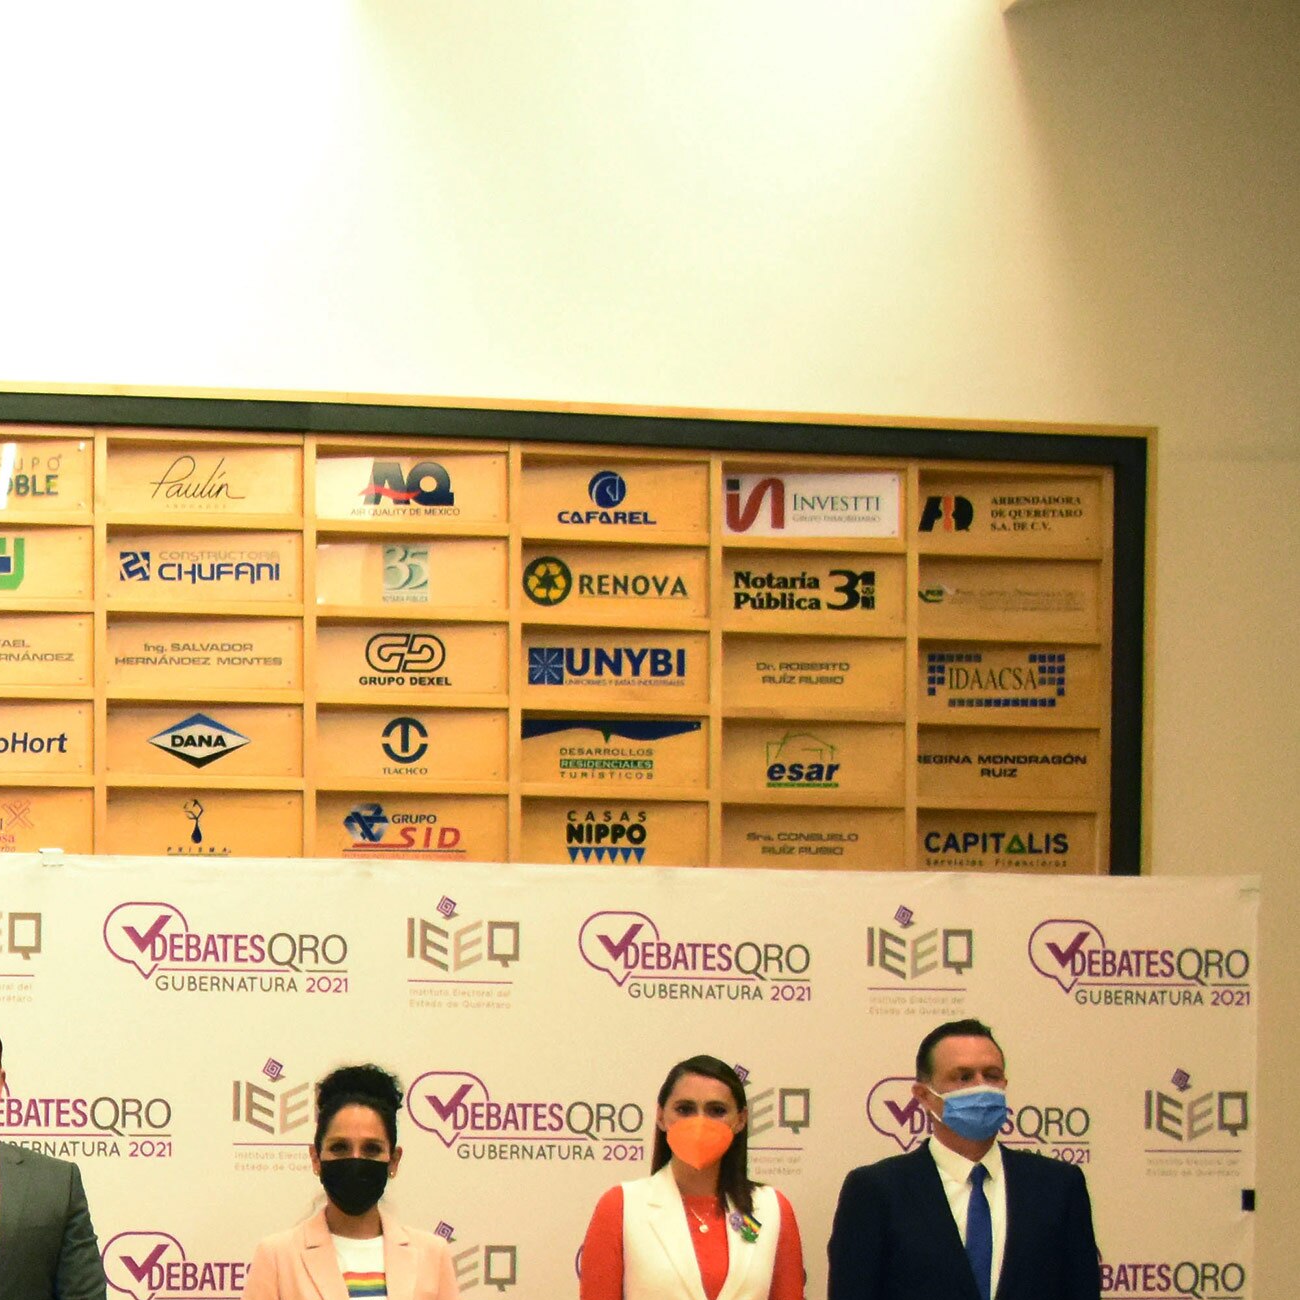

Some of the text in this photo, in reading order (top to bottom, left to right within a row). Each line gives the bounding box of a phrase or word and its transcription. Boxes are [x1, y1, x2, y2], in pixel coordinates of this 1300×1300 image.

[558, 511, 656, 524] CAFAREL
[158, 562, 281, 584] CHUFANI
[734, 570, 820, 589] Notaría
[579, 574, 689, 597] RENOVA
[734, 591, 822, 610] Pública
[144, 643, 253, 653] Ing. SALVADOR
[115, 655, 282, 666] HERNÁNDEZ MONTES
[565, 648, 686, 677] UNYBI
[359, 677, 452, 686] GRUPO DEXEL
[948, 666, 1038, 690] IDAACSA
[171, 735, 226, 748] DANA
[559, 748, 653, 756] DESARROLLOS
[977, 752, 1088, 766] MONDRAGÓN
[561, 760, 652, 769] RESIDENCIALES
[767, 763, 840, 782] esar
[980, 768, 1018, 778] RUIZ
[391, 813, 437, 825] GRUPO
[567, 810, 647, 822] CASAS
[385, 826, 462, 849] SID
[566, 823, 647, 845] NIPPO
[926, 857, 1068, 868] Servicios Financieros
[866, 926, 973, 981] IEEQ
[155, 975, 349, 994] GUBERNATURA 2021
[1074, 988, 1251, 1006] GUBERNATURA 2021
[456, 1141, 645, 1162] GUBERNATURA 2021
